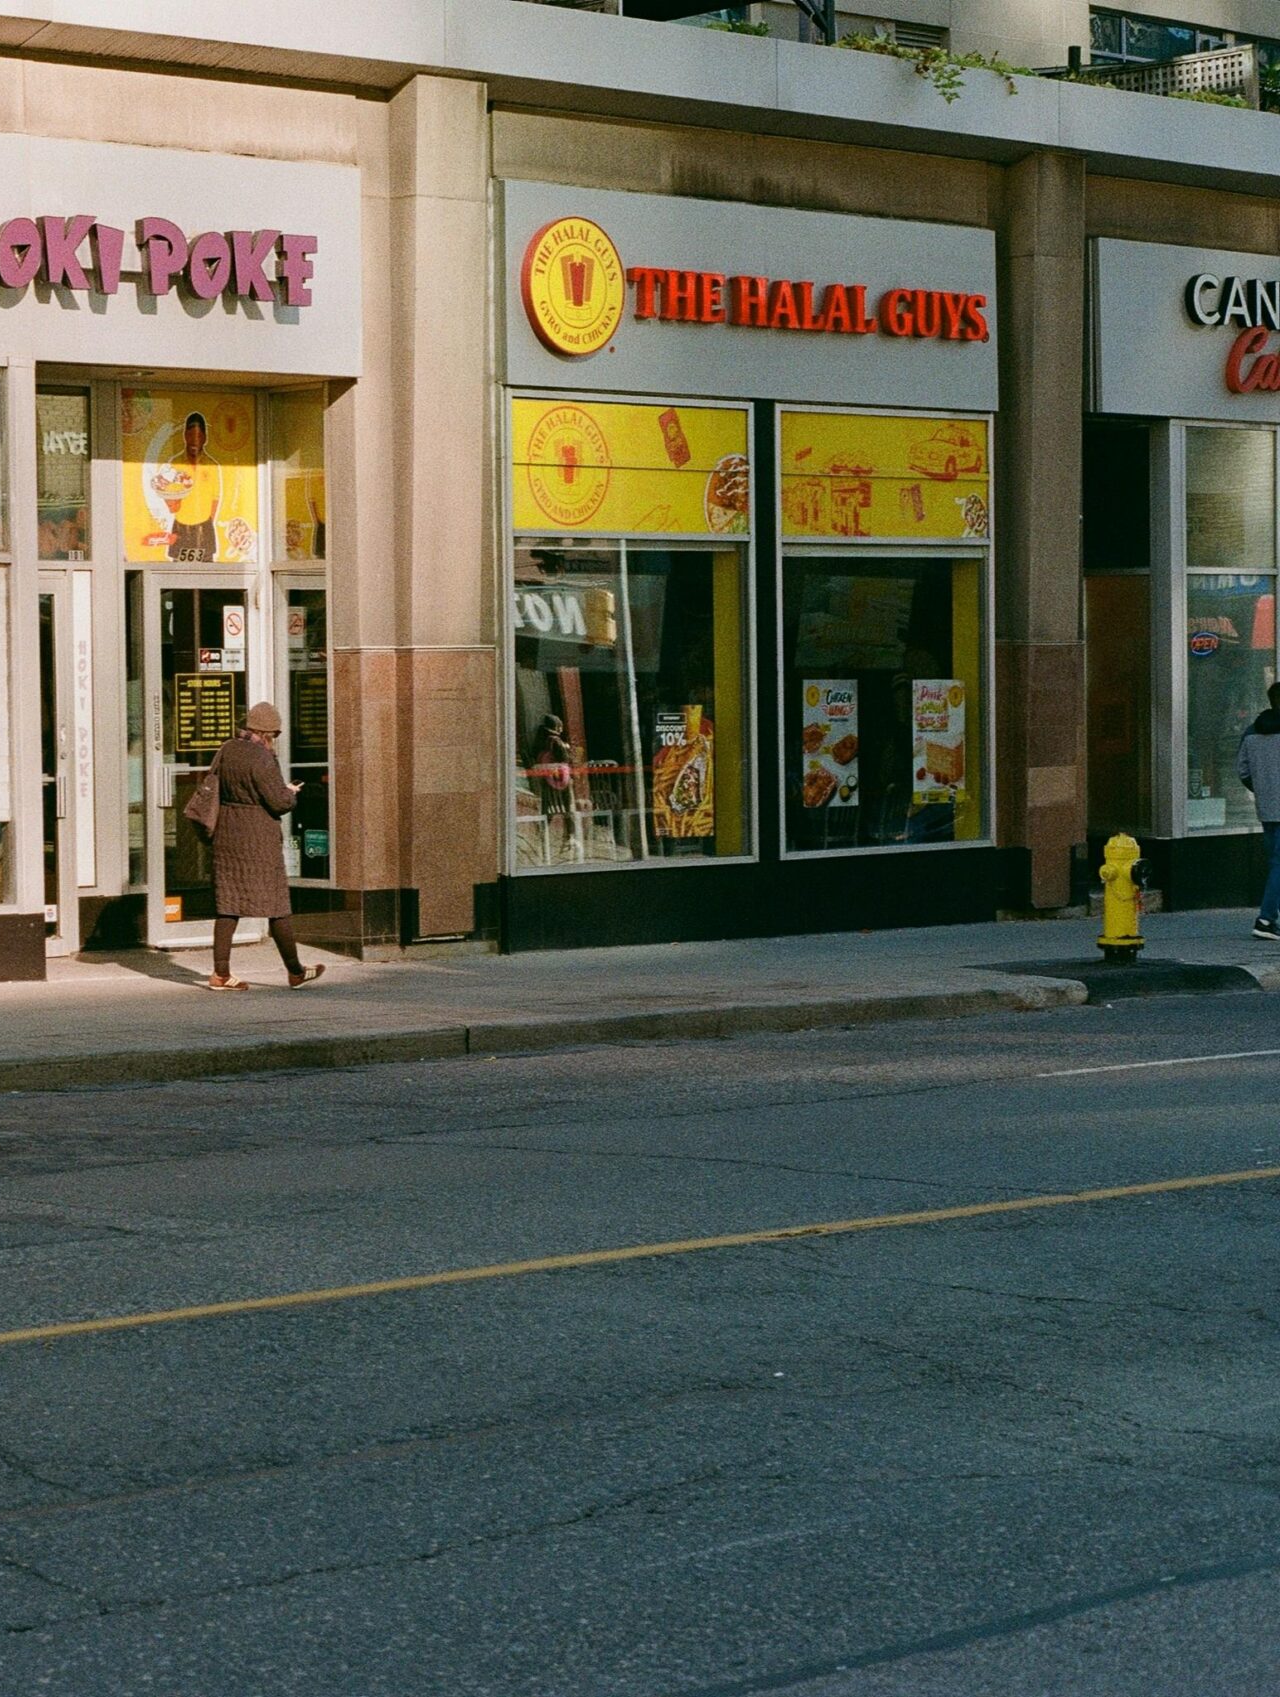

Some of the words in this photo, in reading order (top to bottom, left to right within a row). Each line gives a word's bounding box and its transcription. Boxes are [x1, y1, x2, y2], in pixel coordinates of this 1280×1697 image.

[136, 217, 318, 307] POKE
[534, 243, 555, 277] THE
[551, 224, 593, 246] HALAL
[594, 238, 618, 282] GUYS
[539, 299, 561, 336] GYRO
[562, 332, 580, 345] and
[582, 304, 616, 345] CHICKEN
[627, 266, 726, 324] THE
[730, 275, 878, 335] HALAL
[881, 288, 987, 342] GUYS
[531, 429, 548, 459] THE
[546, 411, 584, 431] HALAL
[584, 425, 606, 464] GUYS
[179, 549, 204, 562] 563
[78, 641, 88, 709] HOKI
[656, 724, 687, 732] DISCOUNT
[661, 732, 687, 747] 10%
[78, 727, 89, 797] POKE
